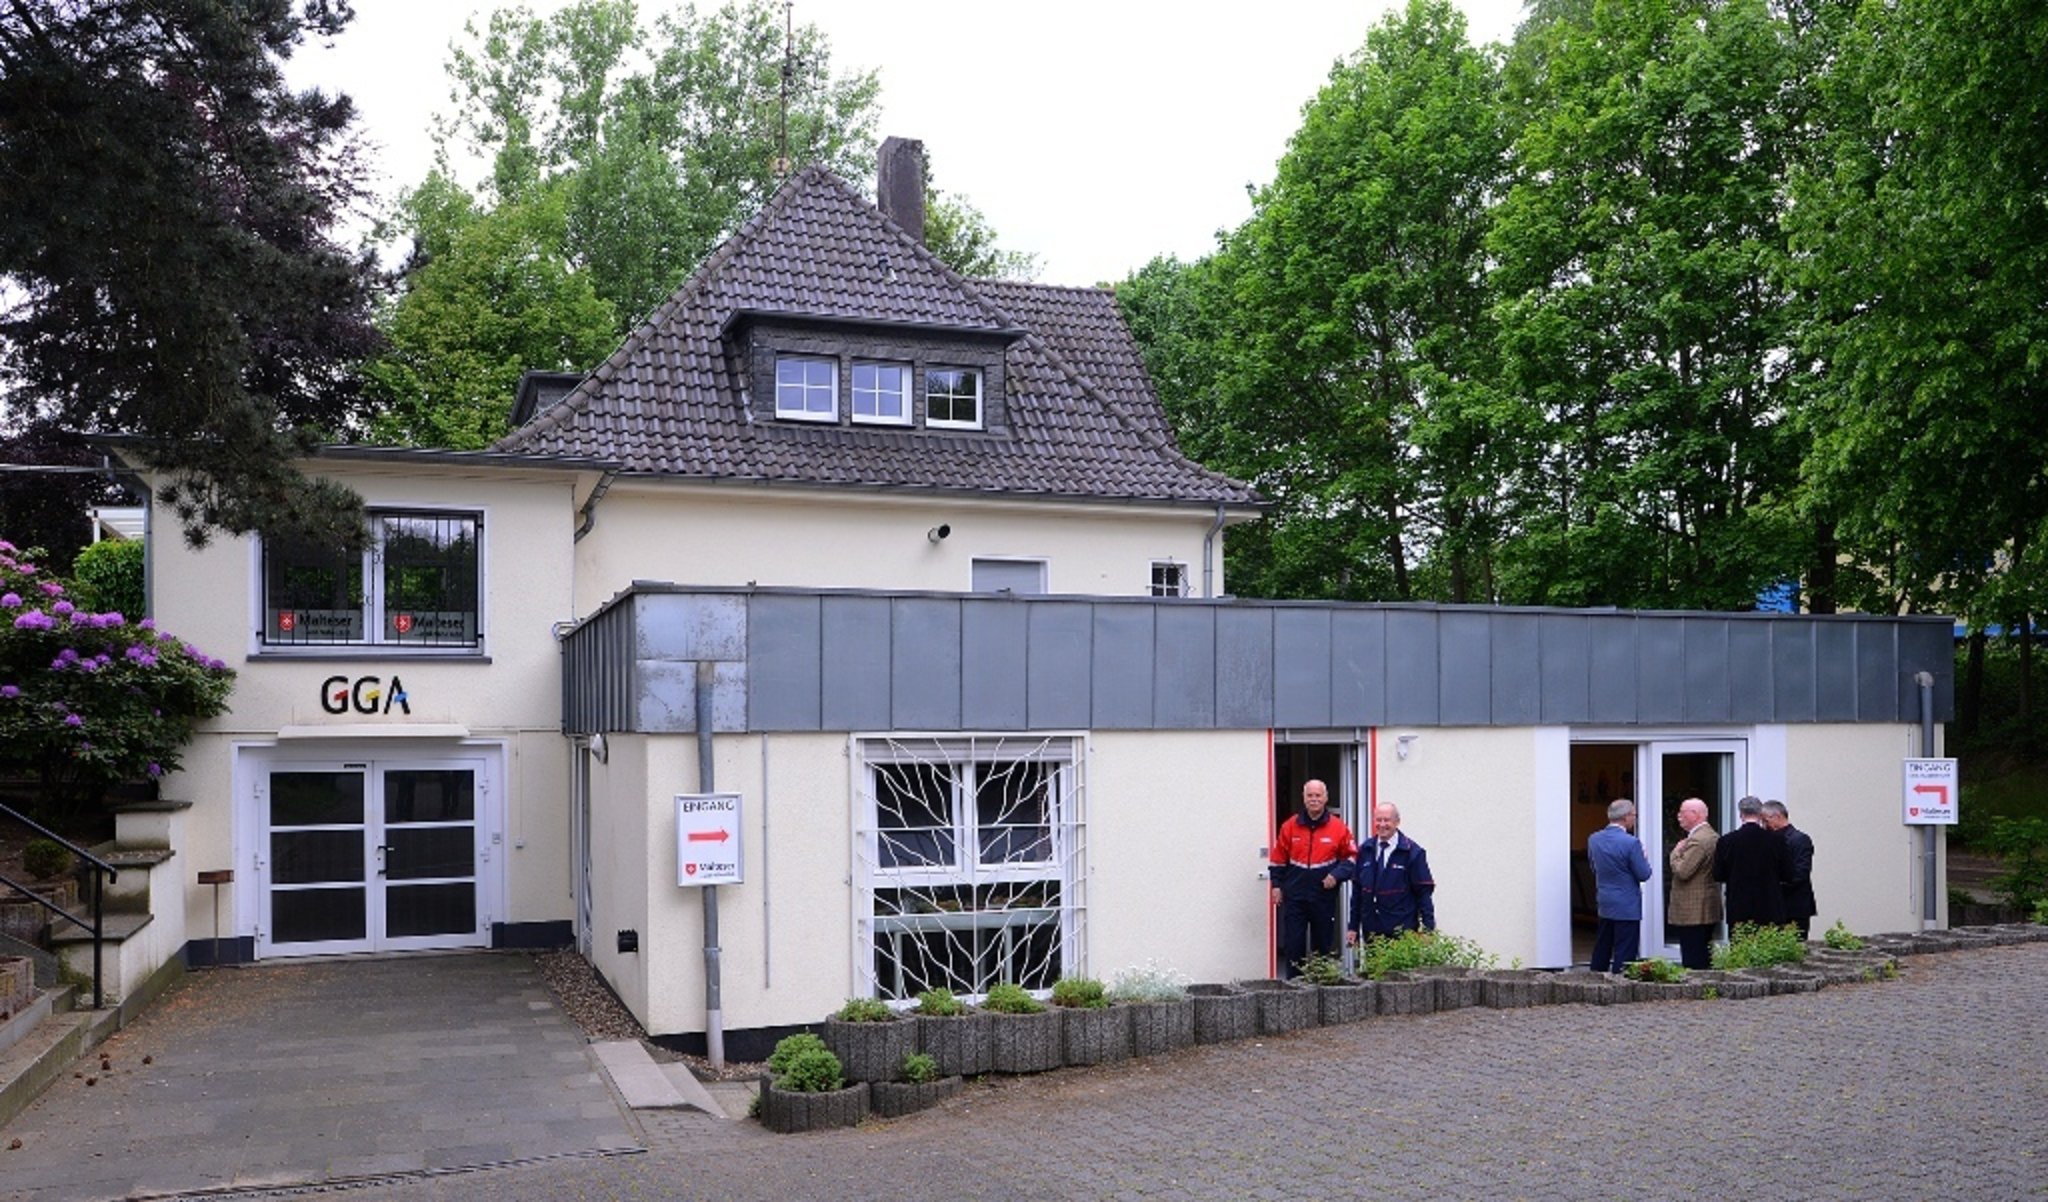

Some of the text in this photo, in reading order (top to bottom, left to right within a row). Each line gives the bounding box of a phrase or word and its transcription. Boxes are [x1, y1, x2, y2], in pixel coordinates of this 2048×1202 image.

[299, 614, 353, 627] Malteser
[321, 675, 411, 715] GGA
[683, 800, 735, 812] EINGANG
